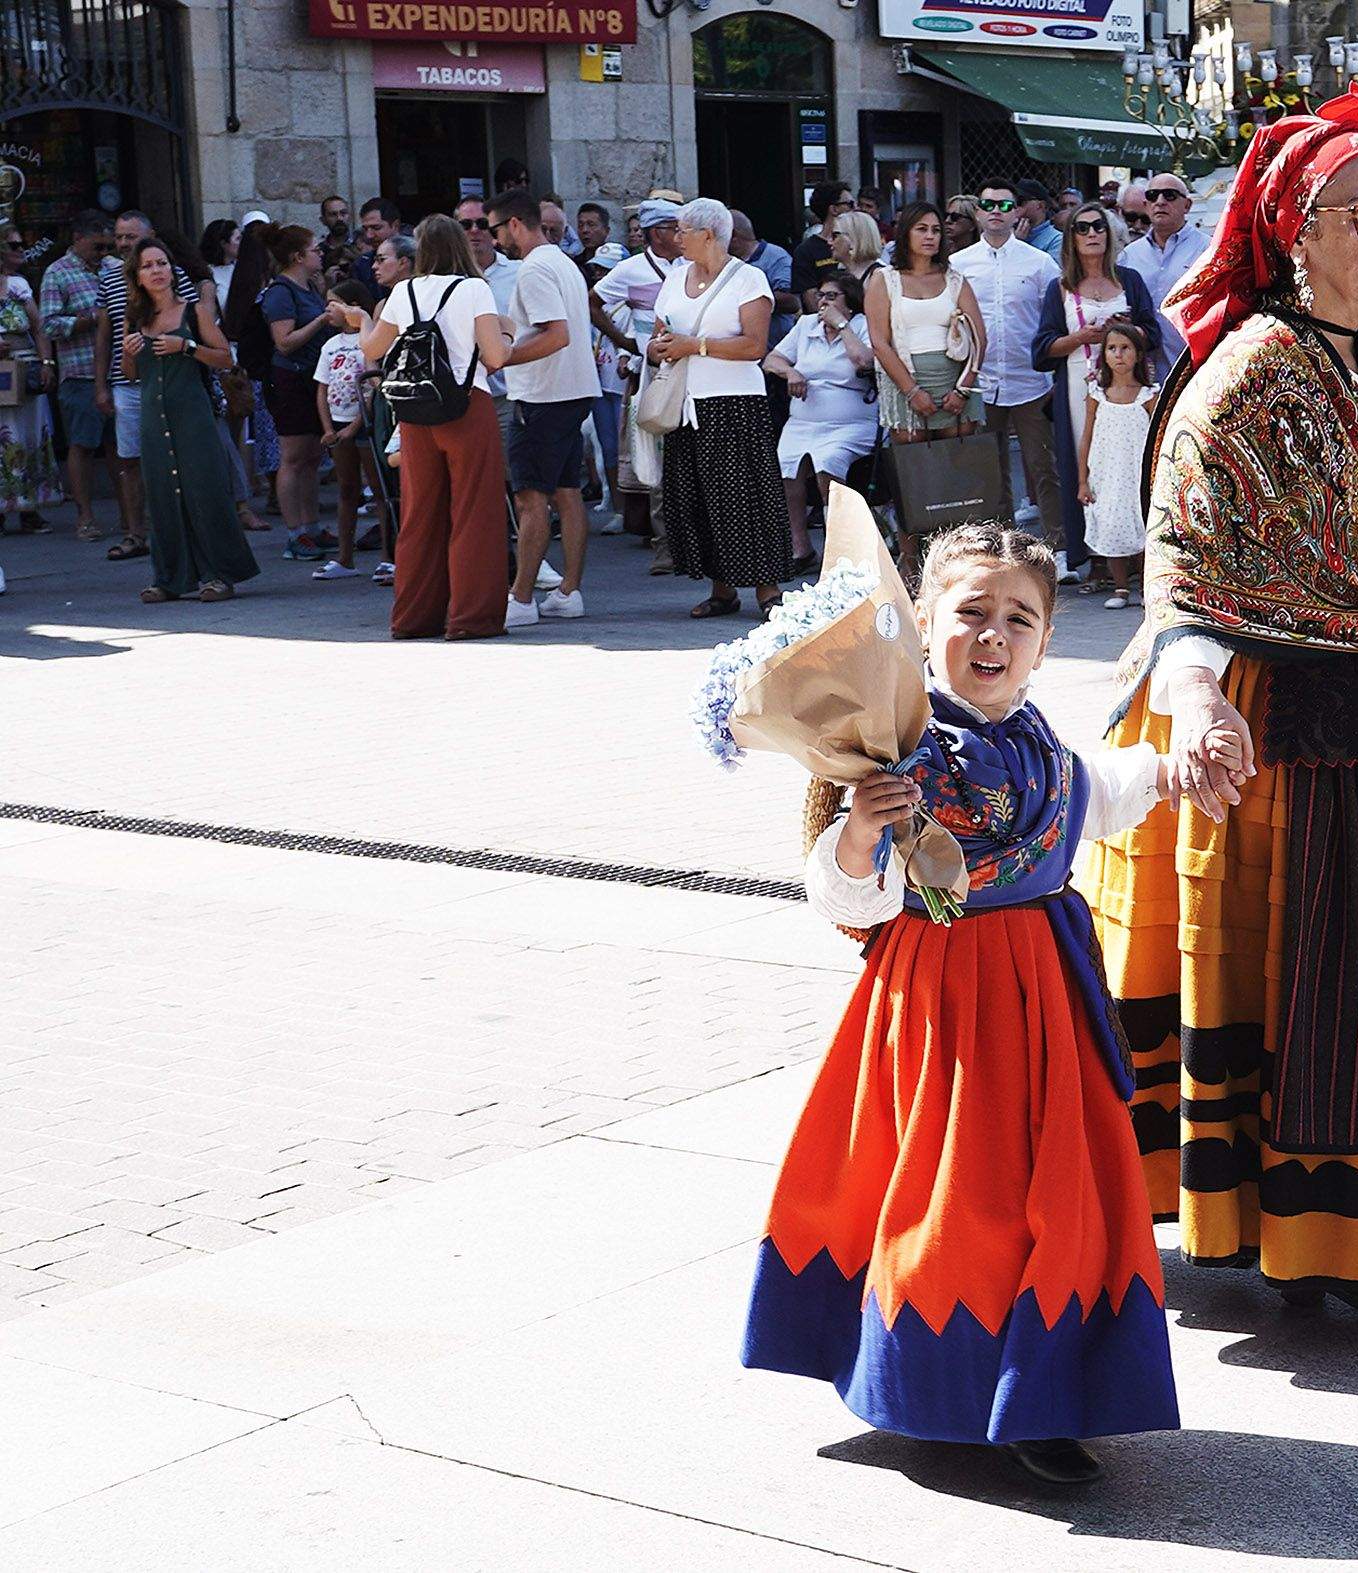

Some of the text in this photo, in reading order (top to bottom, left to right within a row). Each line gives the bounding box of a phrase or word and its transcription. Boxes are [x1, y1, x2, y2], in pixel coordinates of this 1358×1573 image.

[1047, 0, 1086, 13] DIGITAL
[368, 3, 572, 33] EXPENDEDURÍA
[1112, 15, 1132, 27] FOTO
[1107, 30, 1140, 43] OLIMPIO
[417, 67, 502, 86] TABACOS
